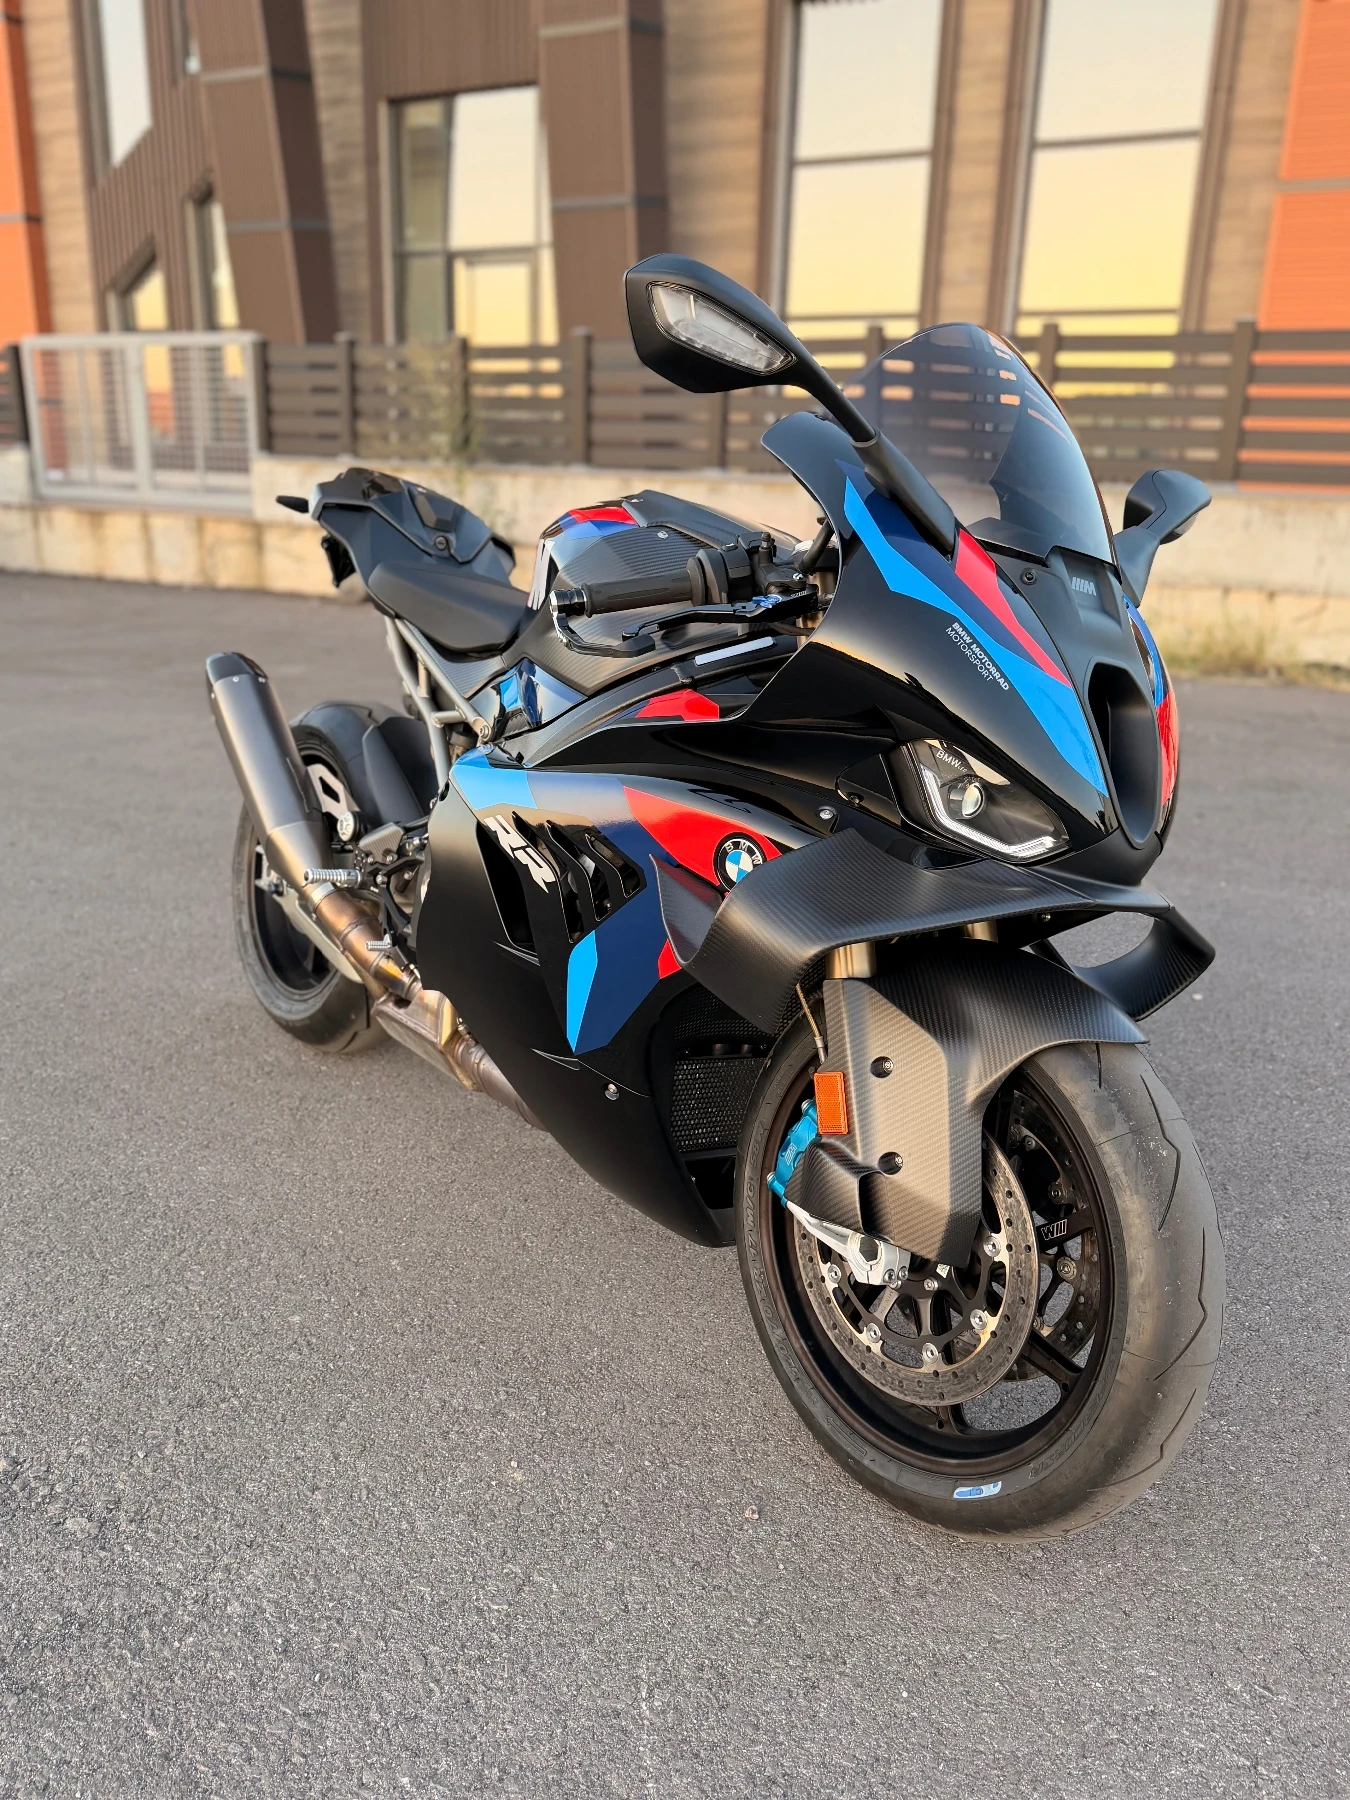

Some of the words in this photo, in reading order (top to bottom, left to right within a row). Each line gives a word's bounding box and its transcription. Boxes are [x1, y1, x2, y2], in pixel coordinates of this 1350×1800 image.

[945, 627, 994, 682] MOTORSPORT
[952, 622, 973, 644] BMW
[970, 643, 1010, 691] MOTORRAD
[936, 750, 962, 768] BMW
[725, 841, 763, 865] BMW
